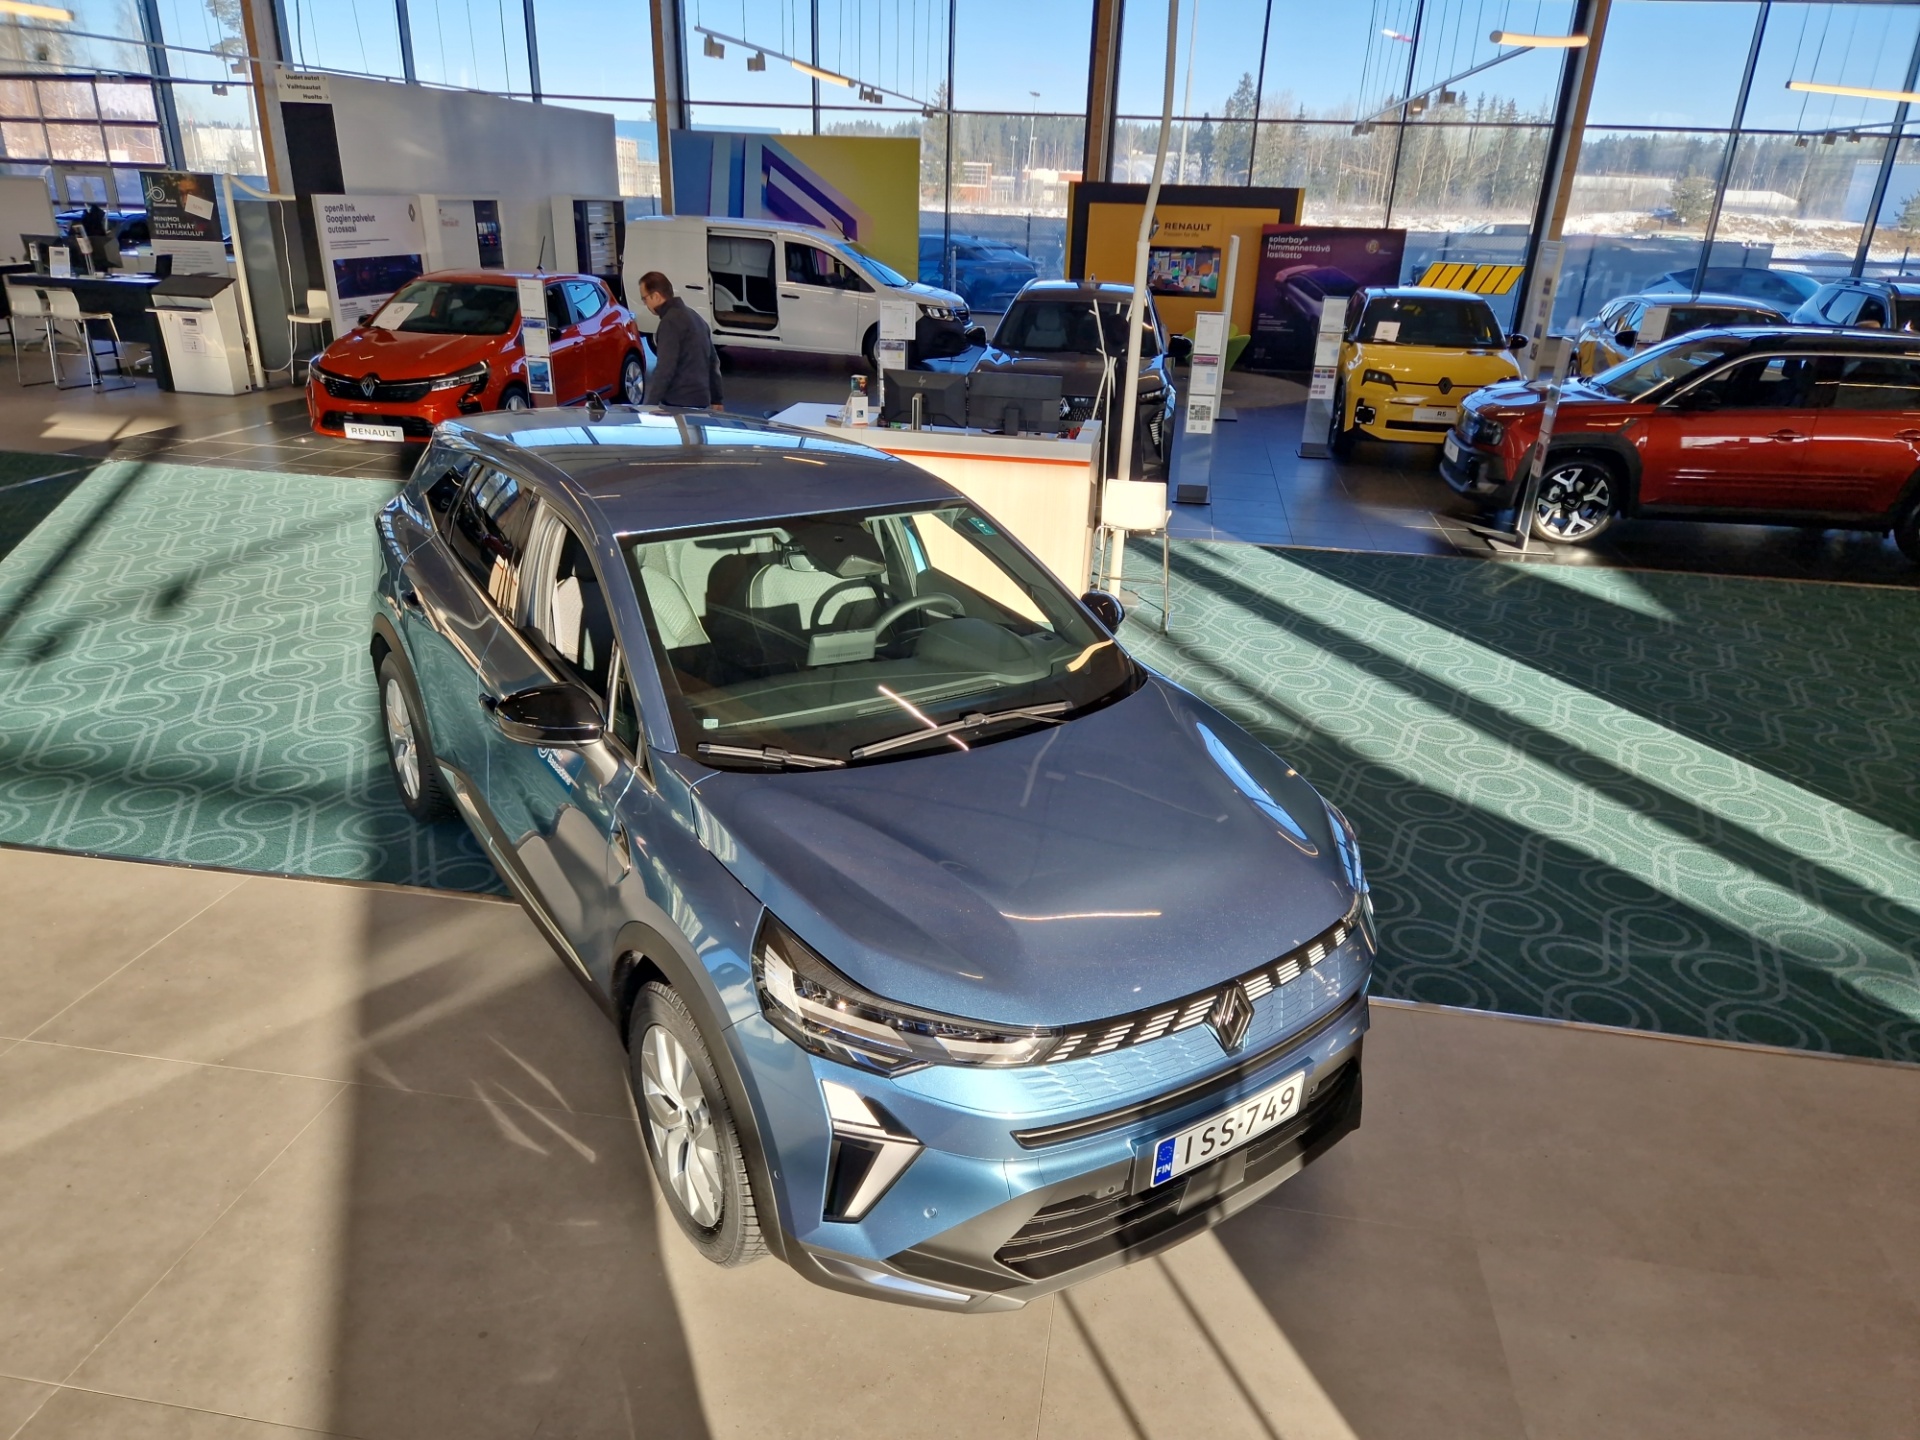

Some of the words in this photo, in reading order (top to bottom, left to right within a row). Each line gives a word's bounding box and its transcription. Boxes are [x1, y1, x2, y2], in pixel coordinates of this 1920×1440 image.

[324, 204, 344, 214] openR
[344, 203, 356, 212] link
[326, 215, 352, 224] Googlen
[352, 214, 376, 224] palvelut
[328, 224, 357, 234] autossasi
[1164, 222, 1212, 231] RENAULT
[1266, 251, 1303, 259] lasikatto
[350, 427, 397, 437] RENAULT
[1184, 1086, 1296, 1166] ISS-749
[1155, 1161, 1172, 1177] FIN
